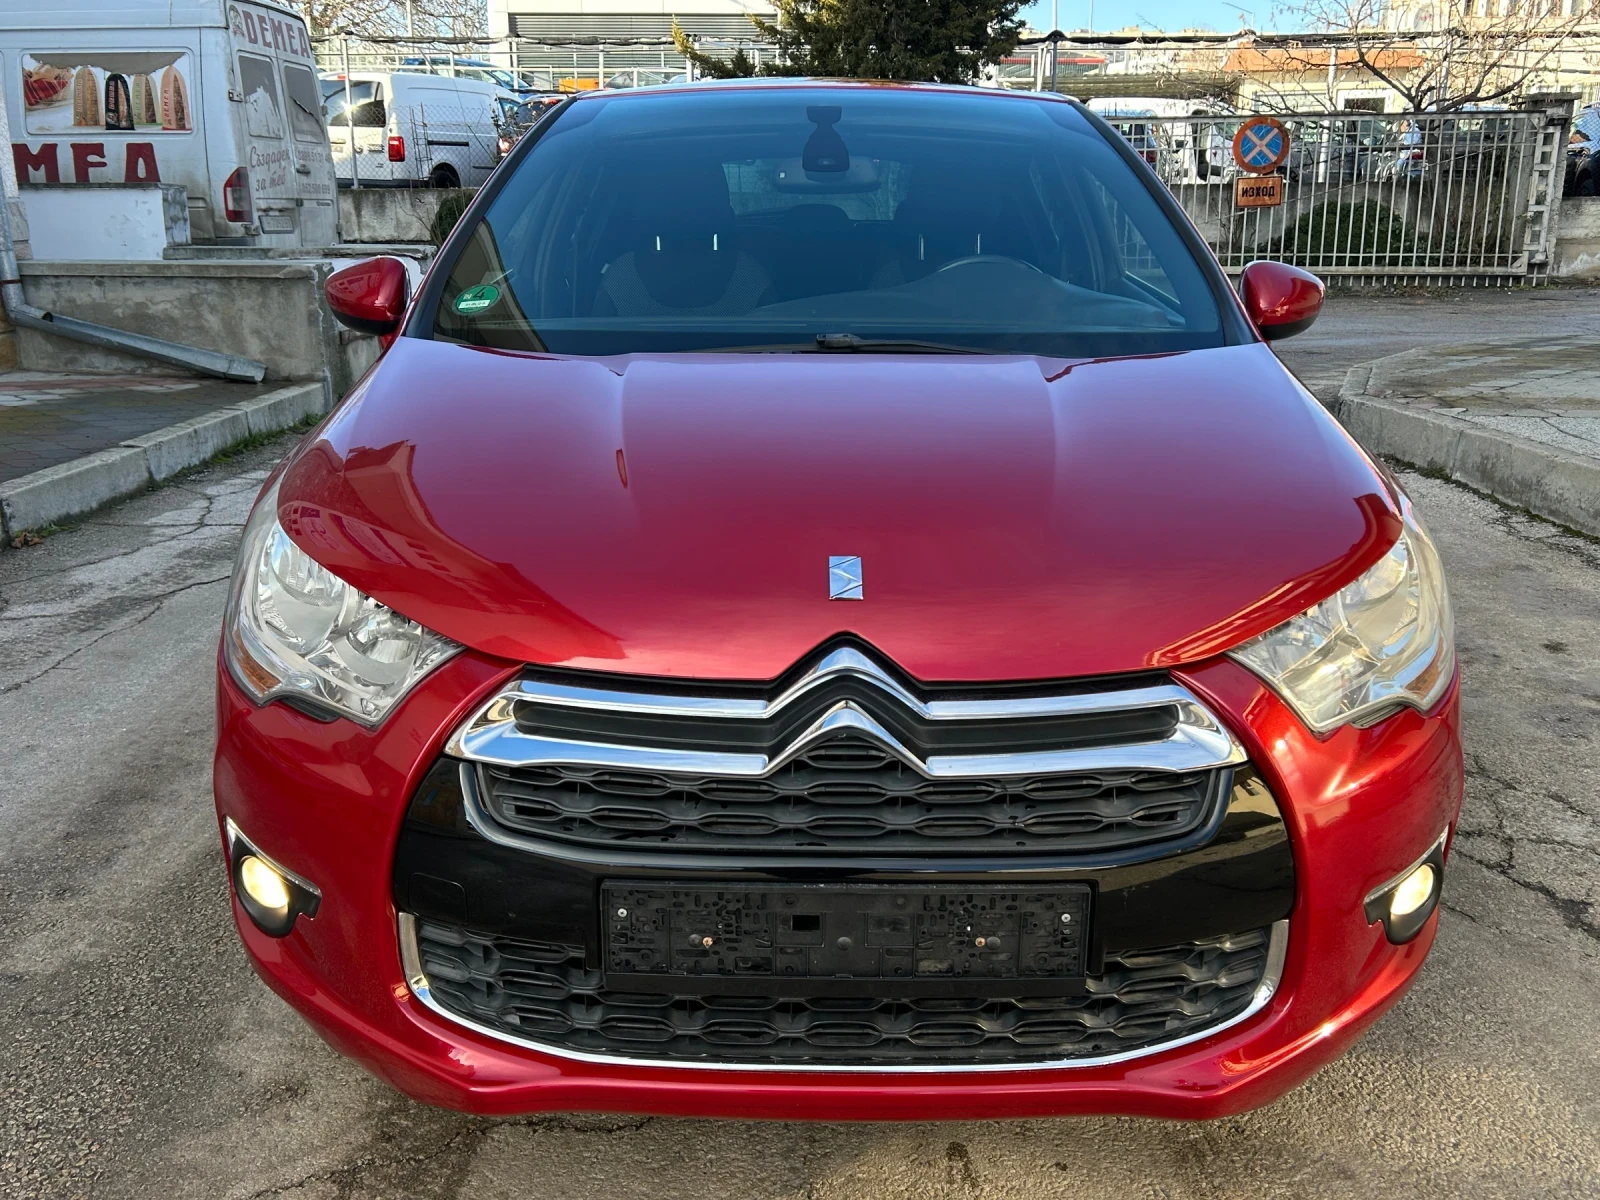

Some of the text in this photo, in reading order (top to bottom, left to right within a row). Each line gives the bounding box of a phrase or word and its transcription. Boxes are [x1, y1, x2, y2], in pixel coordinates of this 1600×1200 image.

[242, 10, 310, 58] DEMEA
[256, 178, 267, 192] за
[1241, 186, 1275, 198] ИЗХОД
[473, 287, 487, 300] 4
